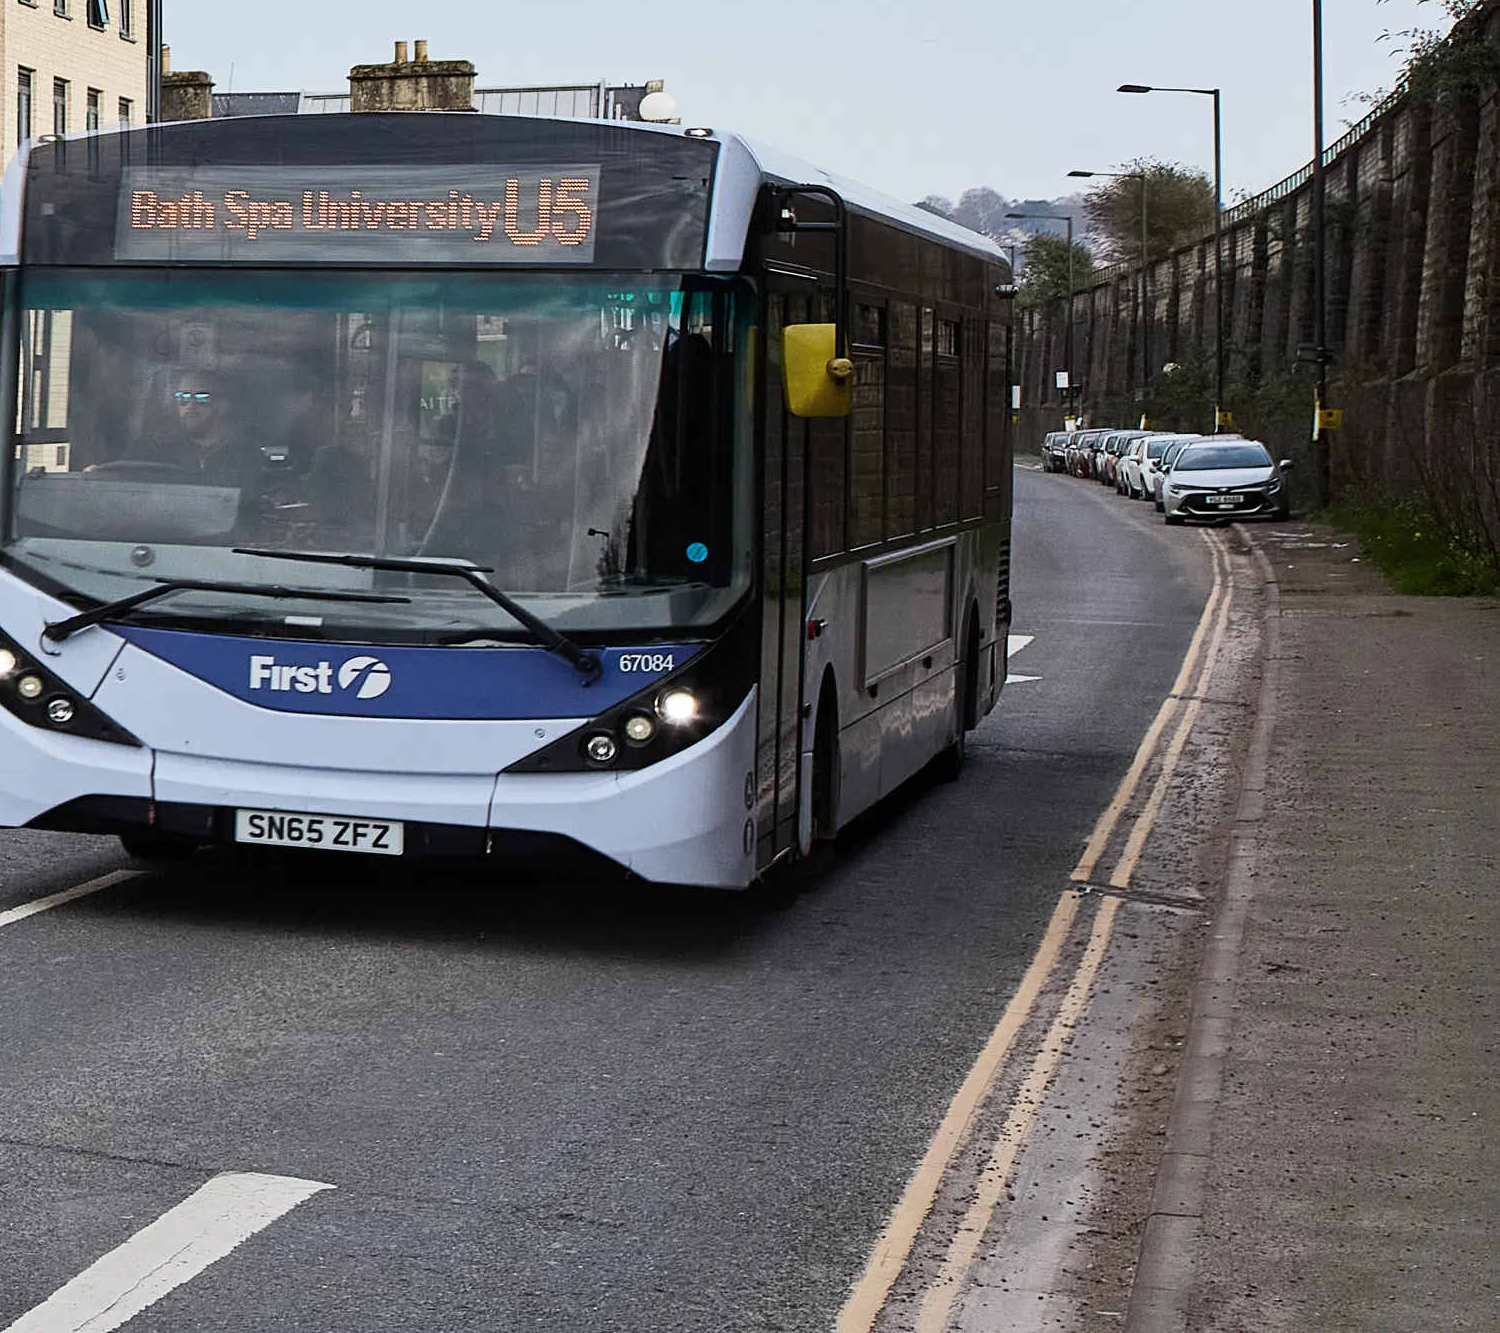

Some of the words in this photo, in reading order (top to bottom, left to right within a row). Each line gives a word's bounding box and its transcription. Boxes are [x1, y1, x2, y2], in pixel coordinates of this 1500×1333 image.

[131, 190, 214, 229] Bath
[224, 190, 293, 240] Spa
[302, 190, 501, 242] University
[505, 178, 594, 246] U5
[249, 655, 333, 694] First
[619, 654, 675, 673] 67084
[248, 814, 324, 844] SN65
[333, 820, 391, 849] ZFZ
